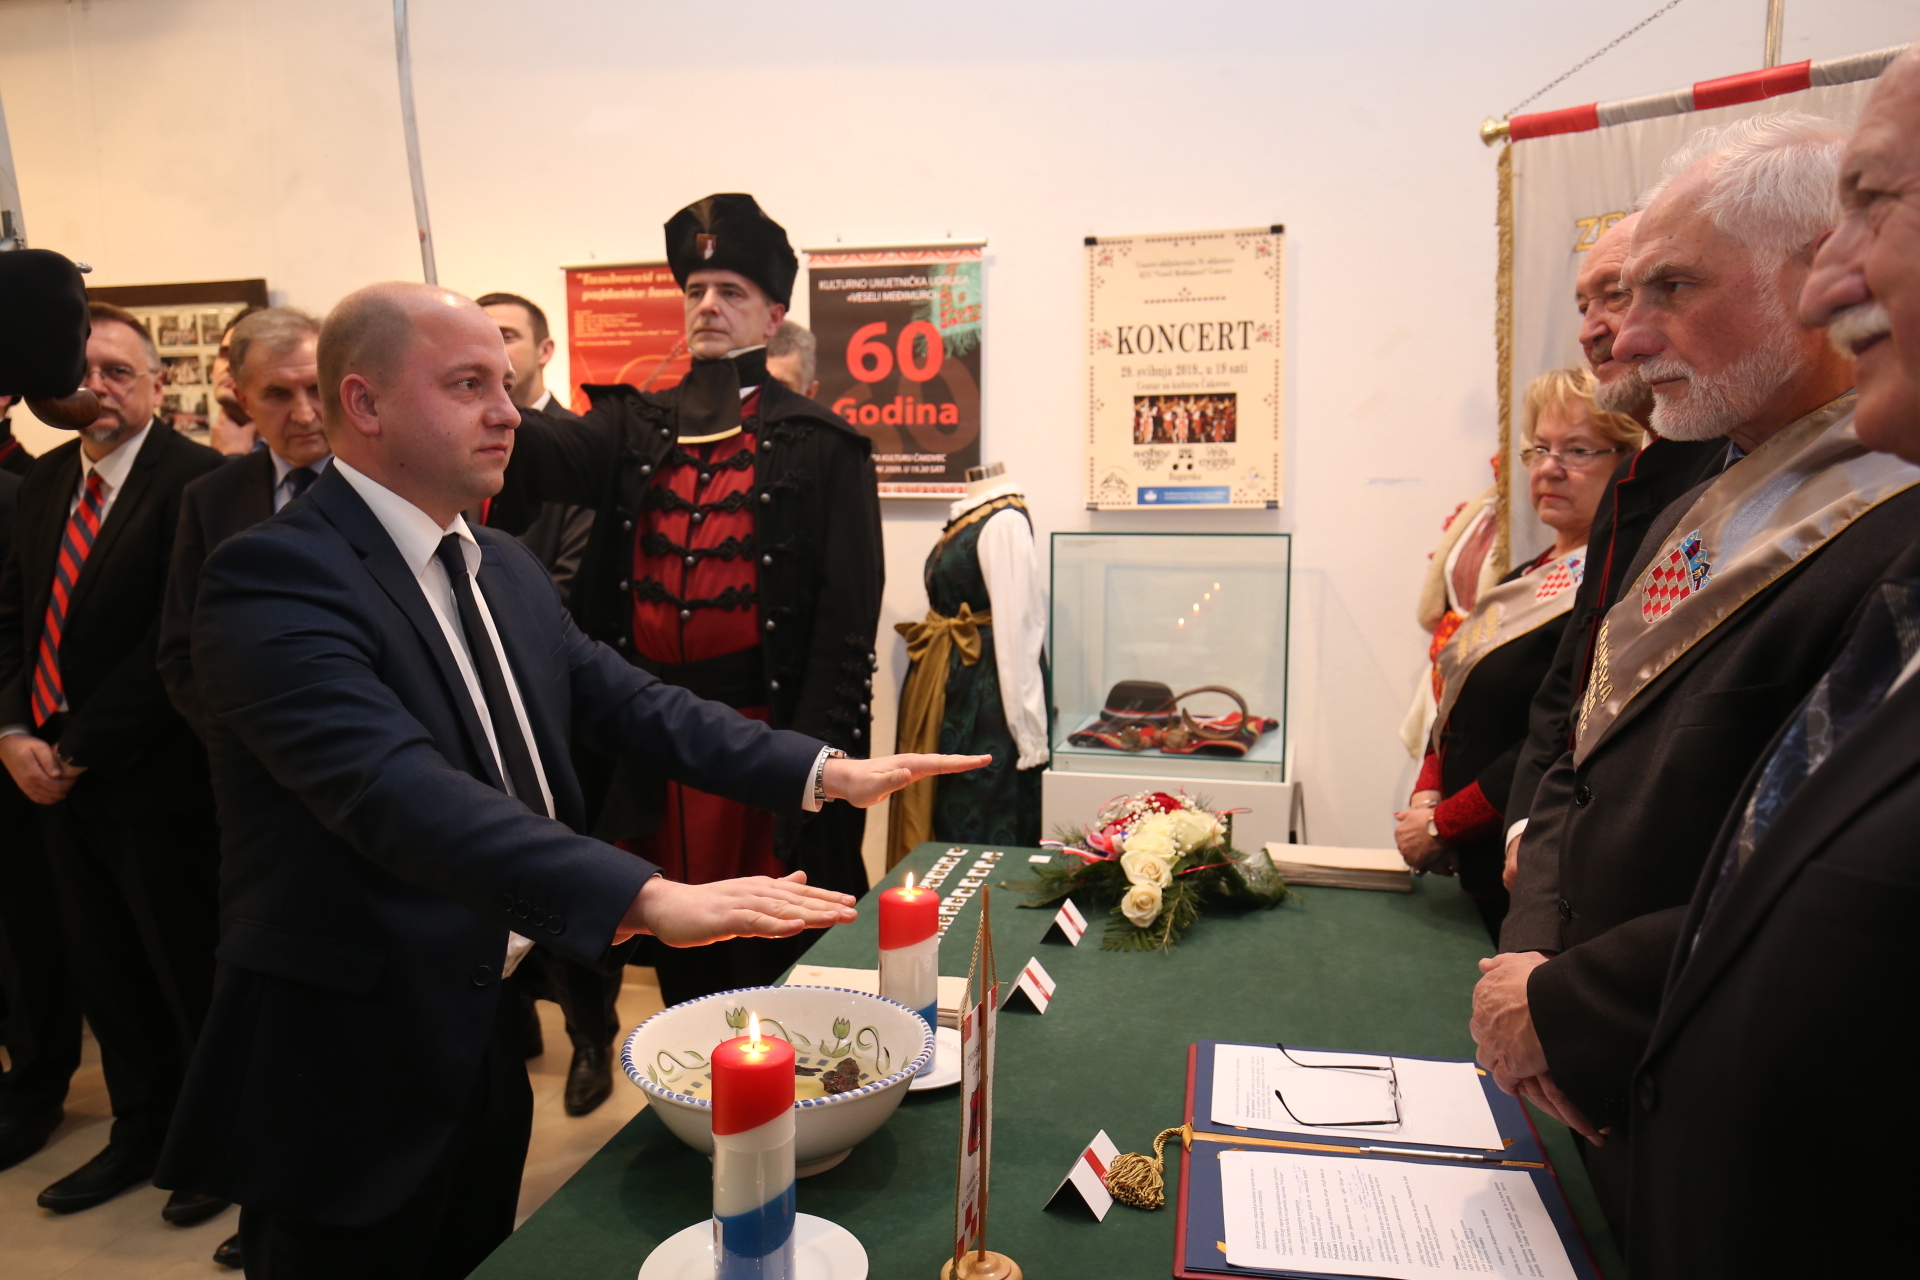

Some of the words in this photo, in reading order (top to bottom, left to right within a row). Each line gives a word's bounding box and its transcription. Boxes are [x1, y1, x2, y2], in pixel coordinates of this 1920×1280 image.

[819, 278, 868, 290] KULTURNO
[846, 320, 944, 383] 60
[1116, 320, 1254, 355] KONCERT
[1137, 364, 1172, 379] svibnja
[1229, 361, 1248, 374] sati
[832, 395, 959, 425] Godina
